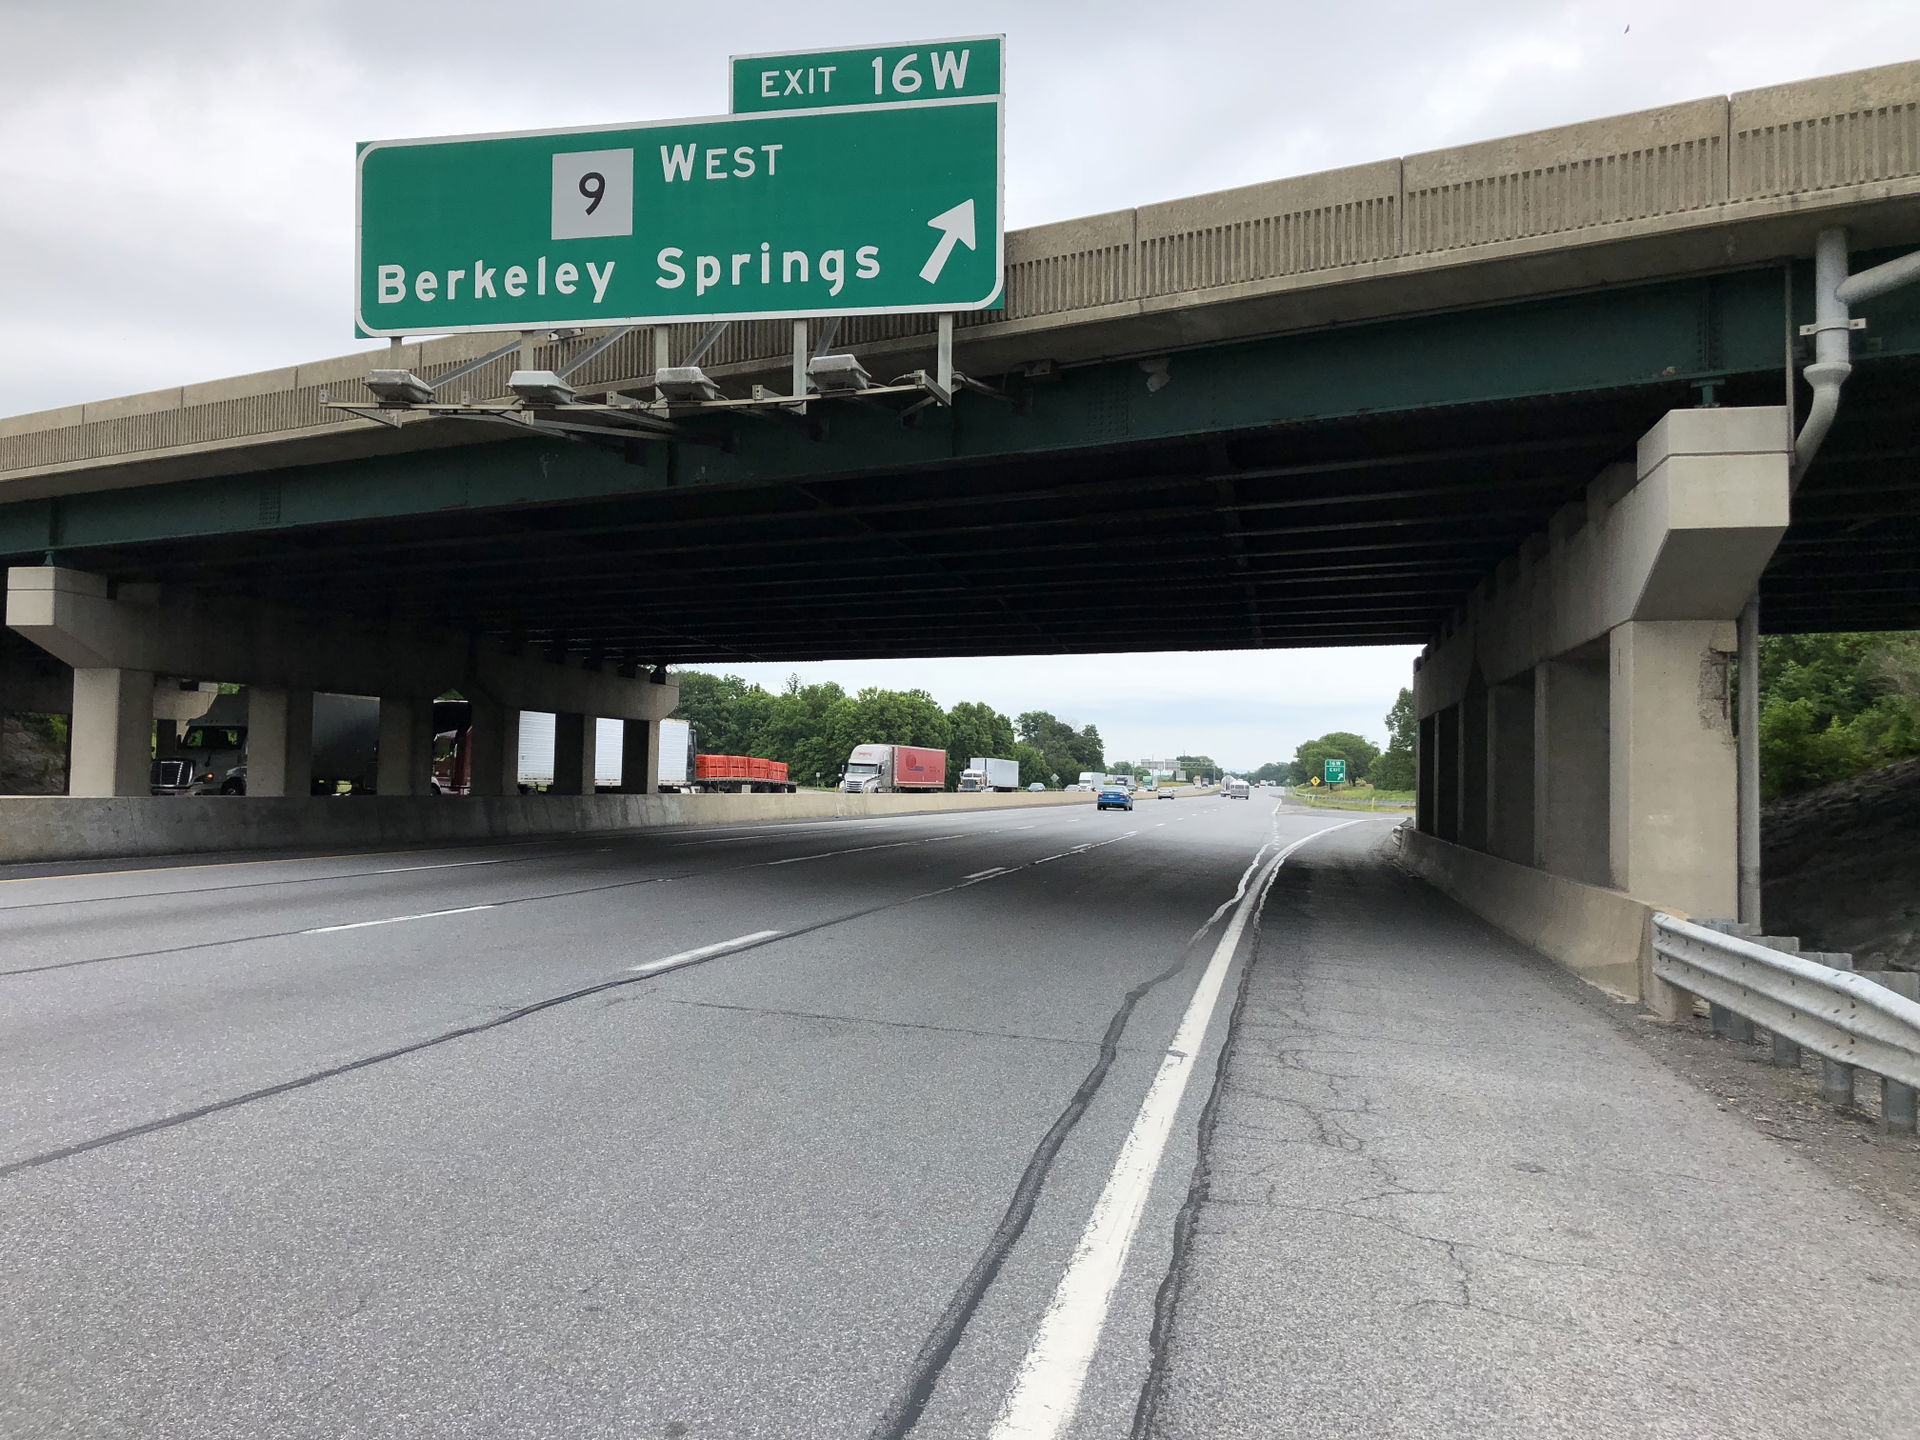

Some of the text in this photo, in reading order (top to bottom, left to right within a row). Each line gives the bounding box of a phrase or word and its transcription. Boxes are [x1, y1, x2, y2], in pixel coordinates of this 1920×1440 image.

[761, 49, 971, 97] EXIT 16W
[660, 143, 784, 183] WEST
[578, 171, 606, 216] 9
[377, 241, 881, 304] Berkeley Springs
